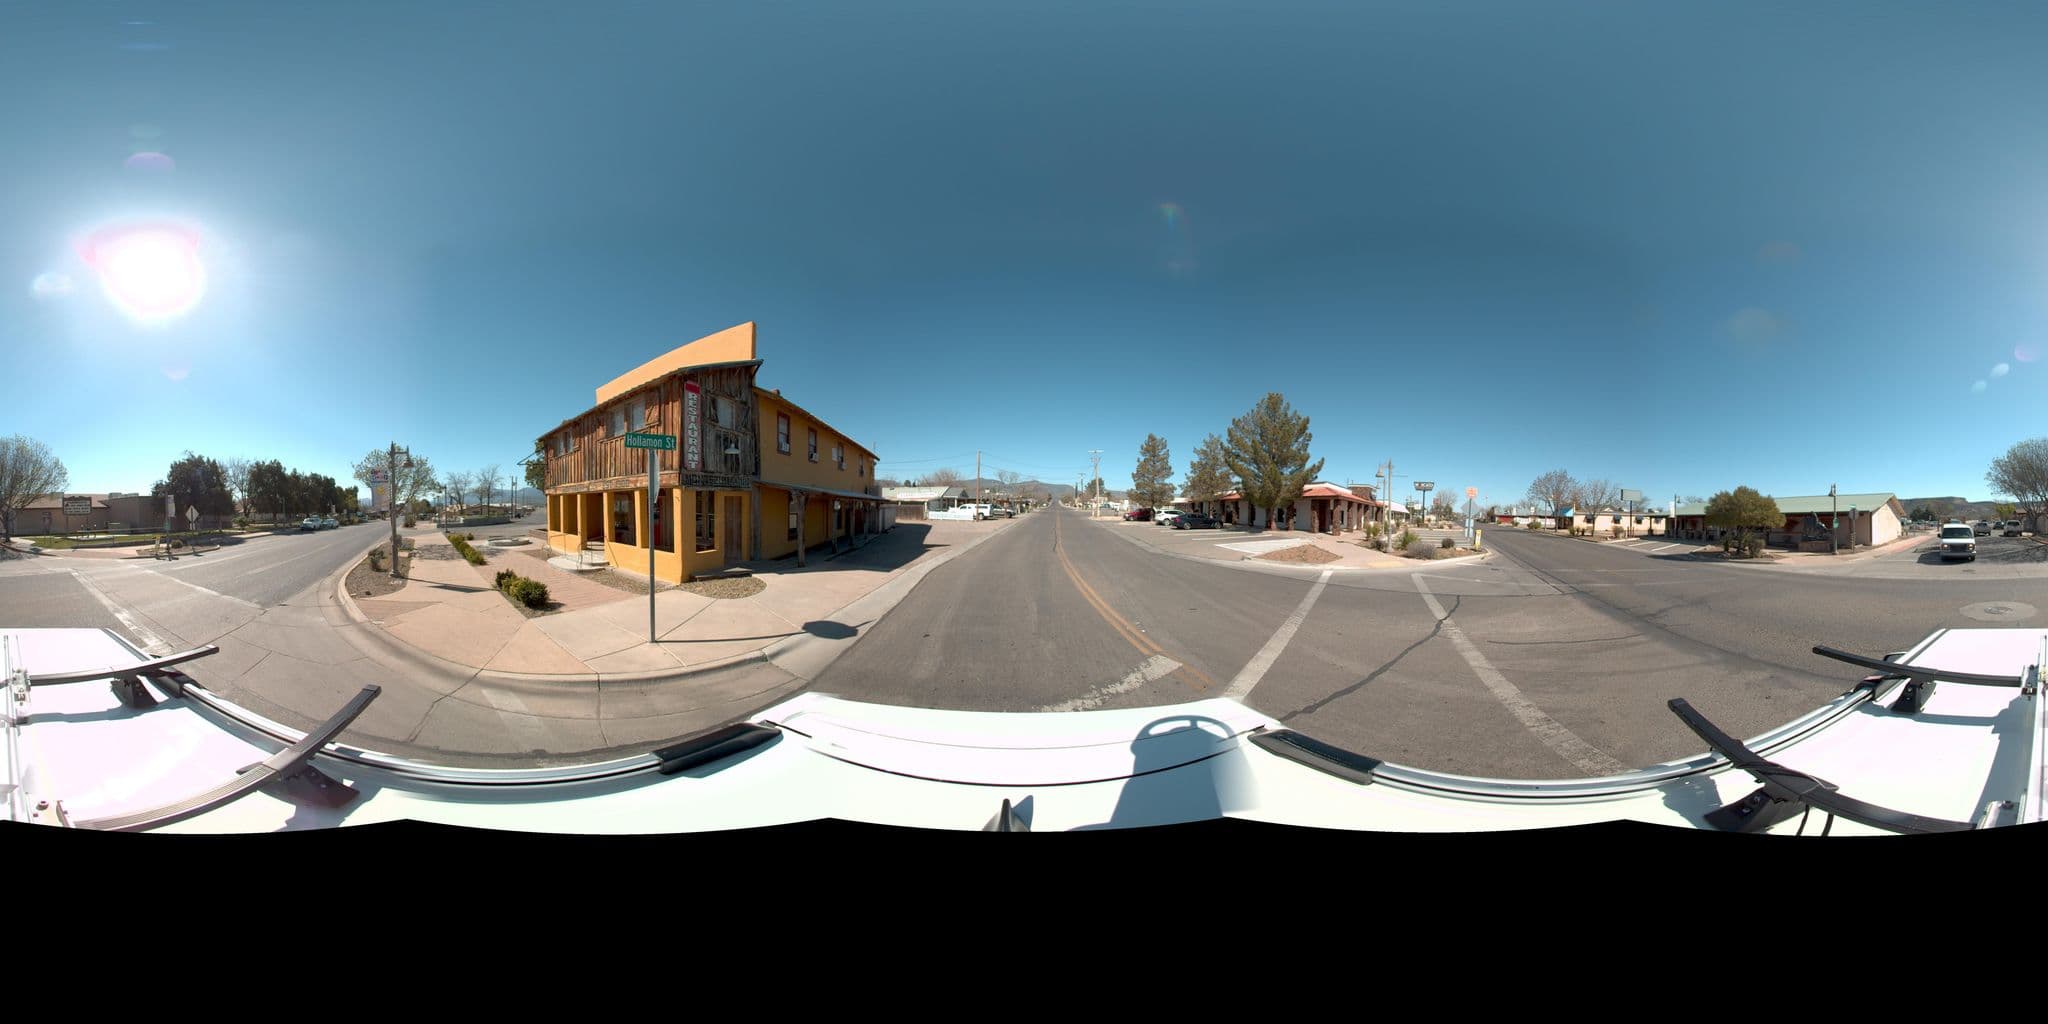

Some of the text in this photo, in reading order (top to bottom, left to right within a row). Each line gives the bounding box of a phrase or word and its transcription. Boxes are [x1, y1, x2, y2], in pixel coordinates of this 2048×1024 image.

[626, 434, 675, 449] Hollamon St
[687, 392, 699, 469] RESTAURANT
